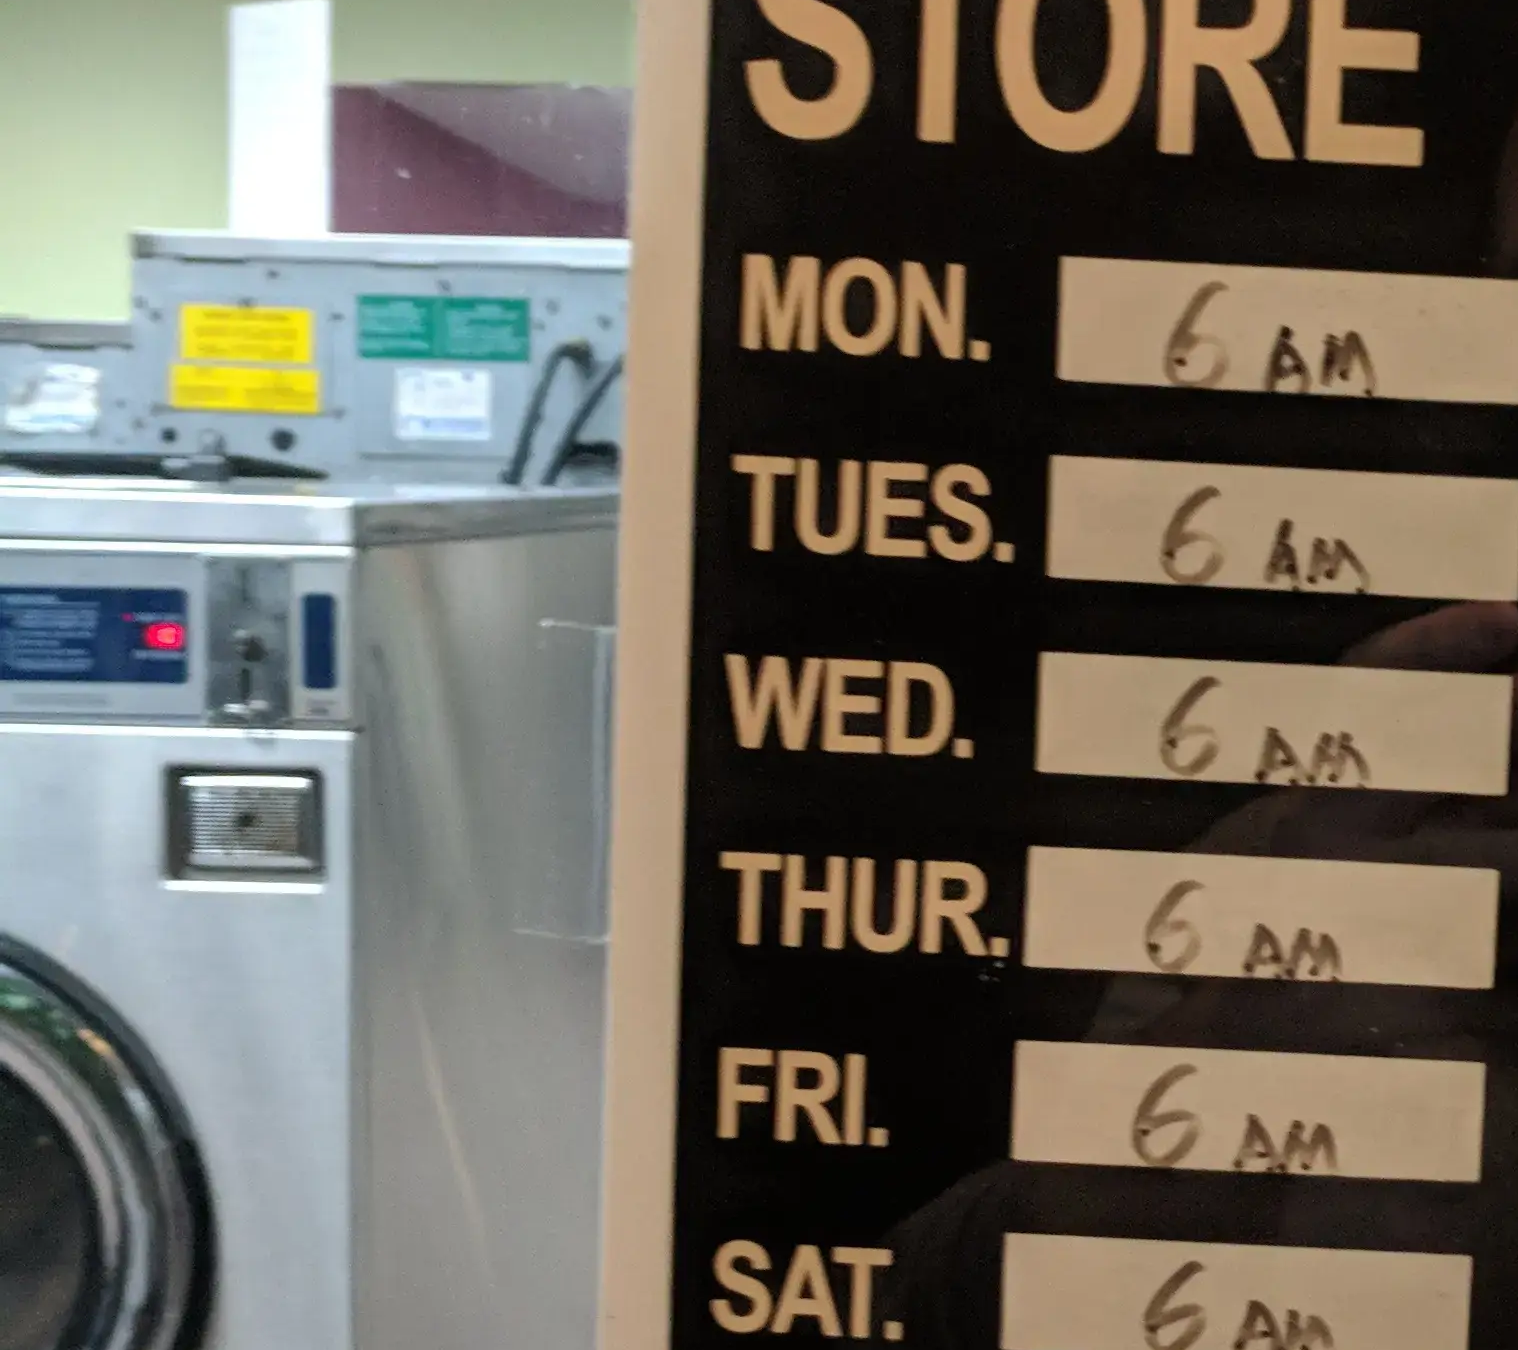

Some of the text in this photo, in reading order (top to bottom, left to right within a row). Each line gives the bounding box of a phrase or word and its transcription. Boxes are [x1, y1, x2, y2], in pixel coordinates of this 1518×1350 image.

[743, 254, 988, 360] MON.
[1163, 281, 1229, 388] 6
[1263, 326, 1376, 396] AM
[734, 455, 1013, 561] TUES.
[1161, 486, 1224, 586] 6
[1264, 519, 1370, 594] AM
[726, 655, 971, 757] WED.
[1161, 676, 1221, 776] 6
[1255, 728, 1371, 788] AM
[722, 852, 1008, 956] THUR.
[1145, 880, 1205, 972] 6
[1243, 923, 1343, 982] AM
[719, 1048, 887, 1146] FRI.
[1131, 1065, 1201, 1167] 6
[1233, 1115, 1338, 1174] AM
[713, 1240, 901, 1339] SAT.
